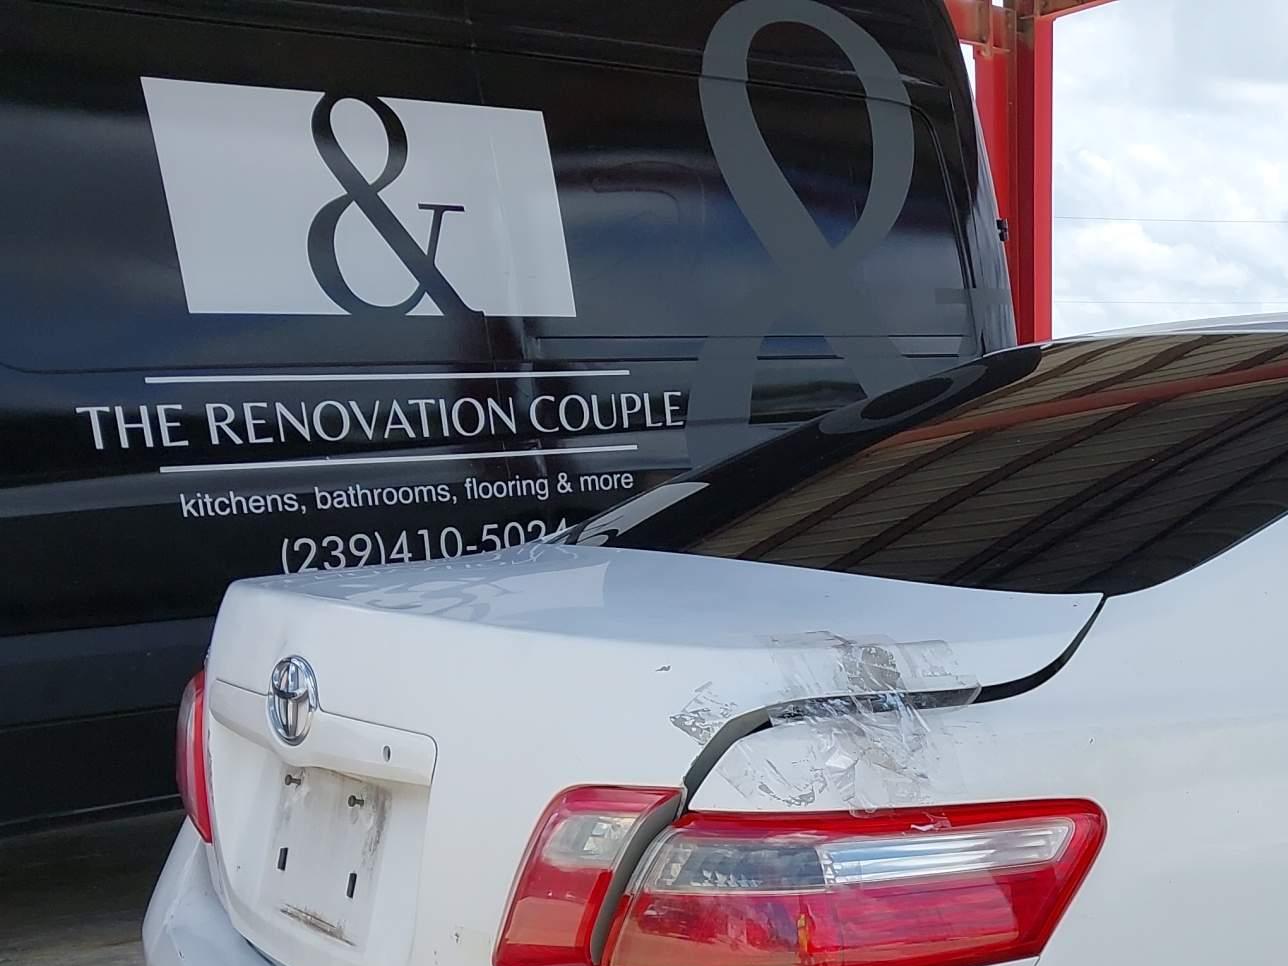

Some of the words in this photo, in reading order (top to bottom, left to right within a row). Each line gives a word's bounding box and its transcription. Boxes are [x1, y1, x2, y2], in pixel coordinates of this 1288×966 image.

[307, 94, 485, 317] &
[75, 404, 190, 450] THE
[205, 397, 518, 445] RENOVATION
[529, 391, 685, 433] COUPLE
[180, 491, 307, 518] kitchens,
[314, 483, 458, 511] bathrooms,
[464, 475, 549, 500] flooring
[556, 473, 572, 494] &
[580, 472, 634, 492] more
